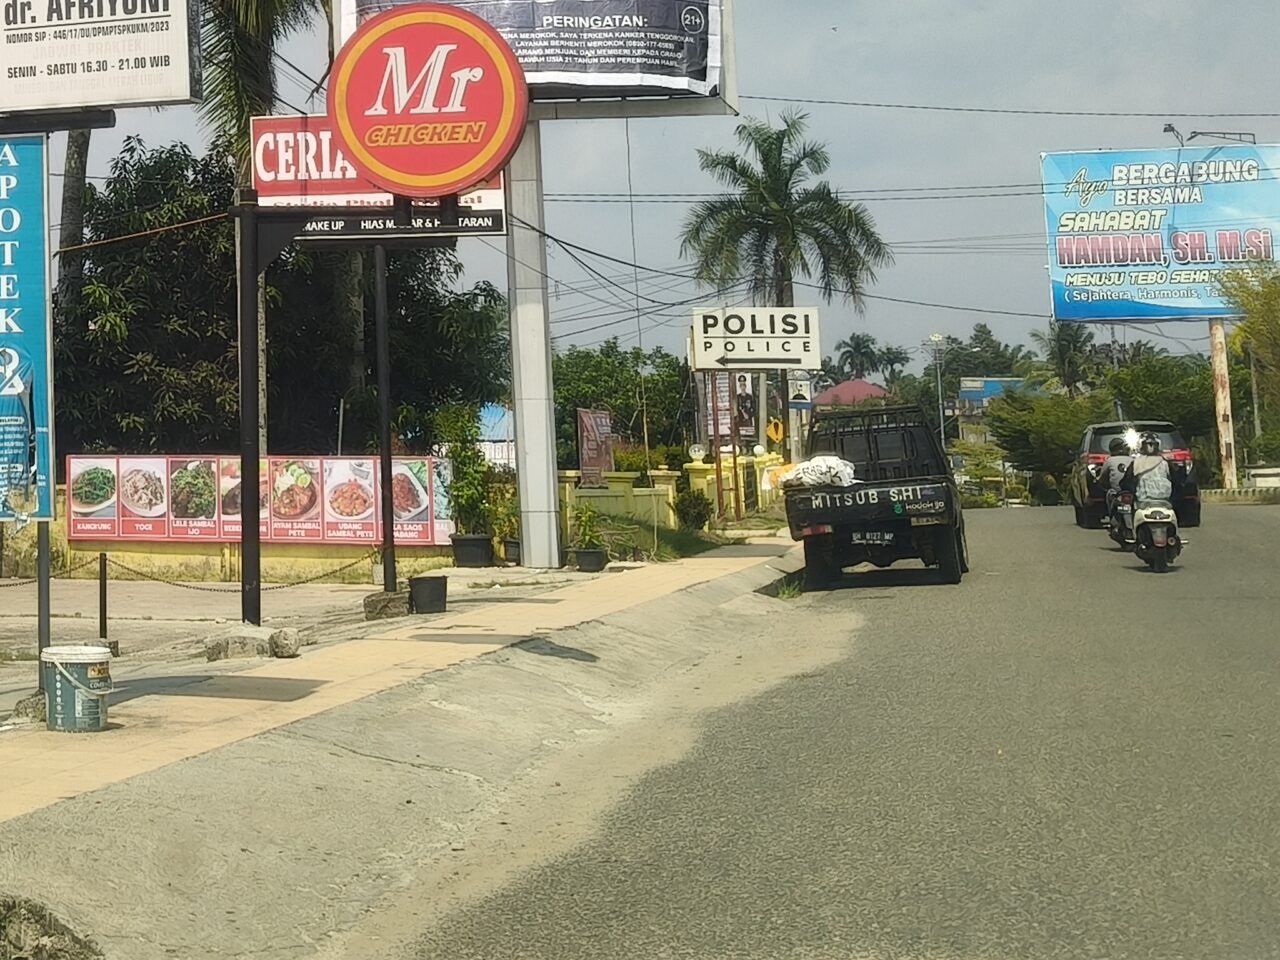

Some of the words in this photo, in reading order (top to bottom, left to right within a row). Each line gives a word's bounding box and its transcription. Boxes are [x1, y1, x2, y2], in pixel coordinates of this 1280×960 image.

[543, 15, 648, 28] PERINGATAN:
[683, 14, 701, 26] 21+
[6, 32, 33, 44] NOMOR
[35, 31, 47, 42] SIP
[7, 66, 37, 78] SENIN
[46, 62, 77, 76] SABTU
[80, 59, 108, 73] 16.30
[118, 57, 147, 71] 21.00
[149, 55, 171, 67] WIB
[364, 44, 484, 116] Mr
[364, 121, 487, 147] CHICKEN
[1064, 168, 1109, 208] Ayo
[1111, 159, 1260, 187] BERGABUNG
[1113, 186, 1203, 206] BERSAMA
[331, 220, 345, 230] UP
[361, 219, 384, 230] HIAS
[1057, 209, 1167, 232] SAHABAT
[1056, 233, 1170, 267] HAMDAN,
[1171, 231, 1215, 264] SH.
[1216, 229, 1273, 262] M.Si
[1065, 271, 1125, 287] MENUJU
[1129, 270, 1167, 285] TEBO
[1072, 290, 1135, 303] Sejahtera,
[1137, 287, 1201, 300] Harmonis,
[702, 313, 810, 335] POLISI
[703, 341, 811, 352] POLICE
[188, 520, 215, 528] SAMBAL
[327, 530, 355, 538] SAMBAL
